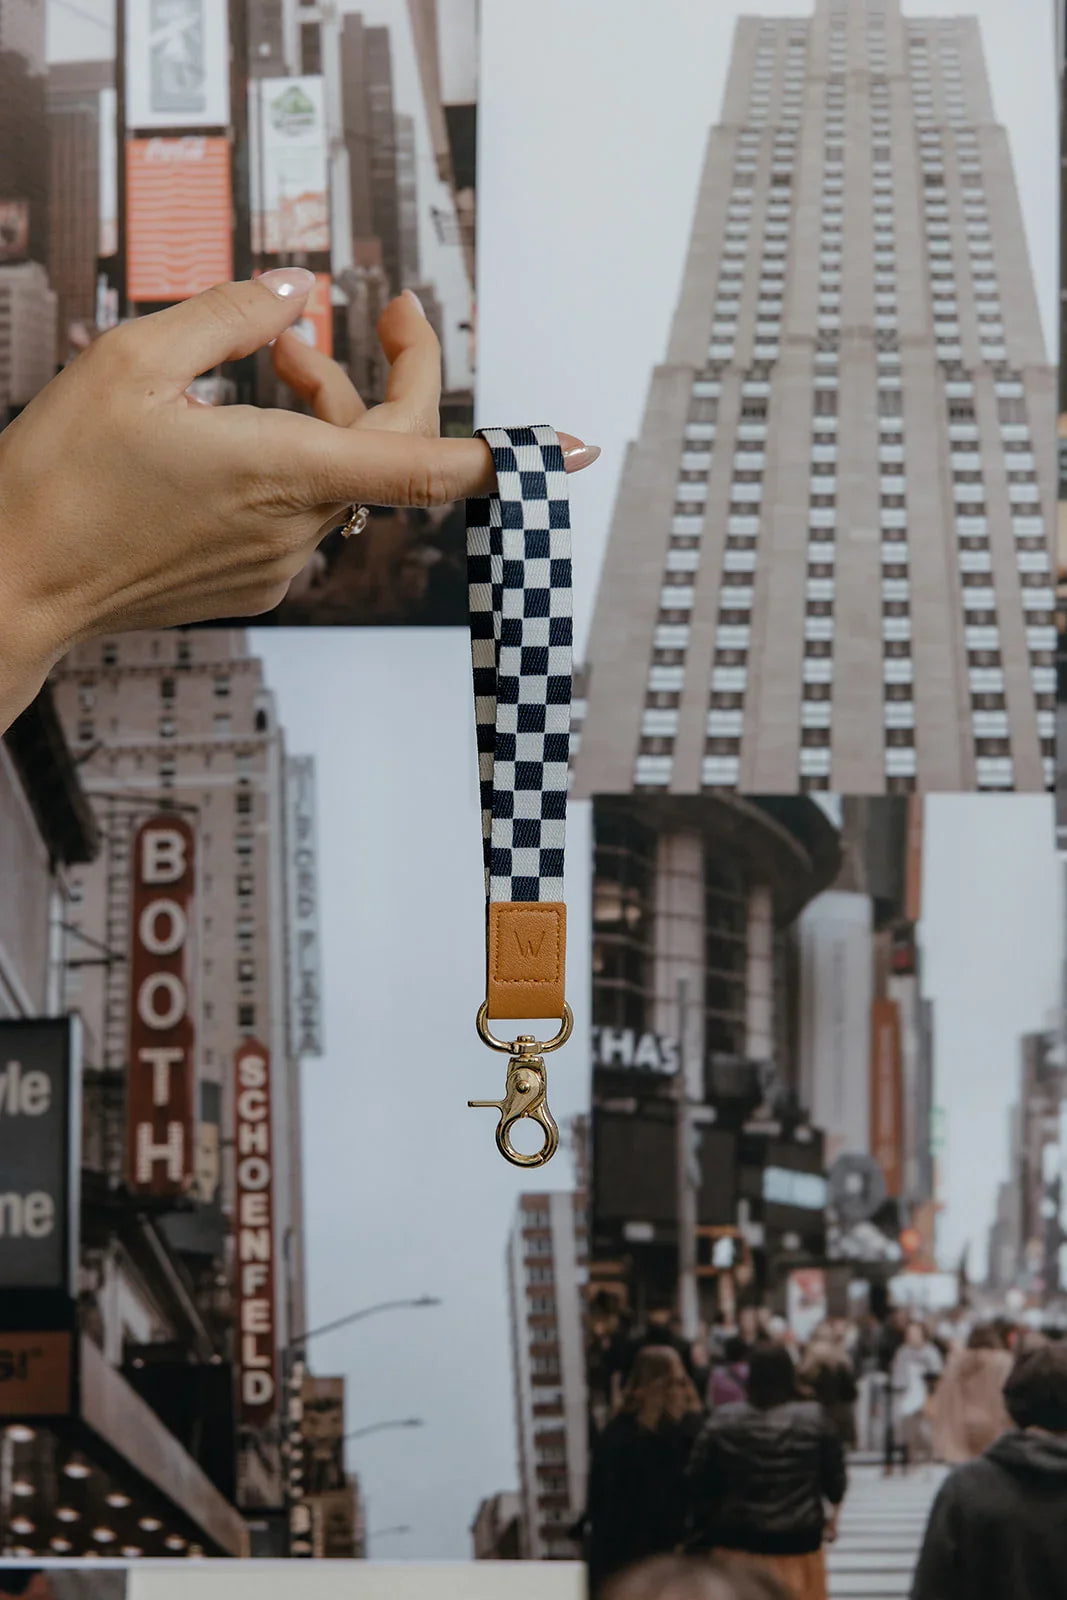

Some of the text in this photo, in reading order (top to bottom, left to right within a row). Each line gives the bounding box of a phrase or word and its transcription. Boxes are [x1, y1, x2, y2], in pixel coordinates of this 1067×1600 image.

[136, 828, 187, 1183] BOOTH
[513, 930, 546, 958] W
[237, 1055, 274, 1406] SCHOENFELD
